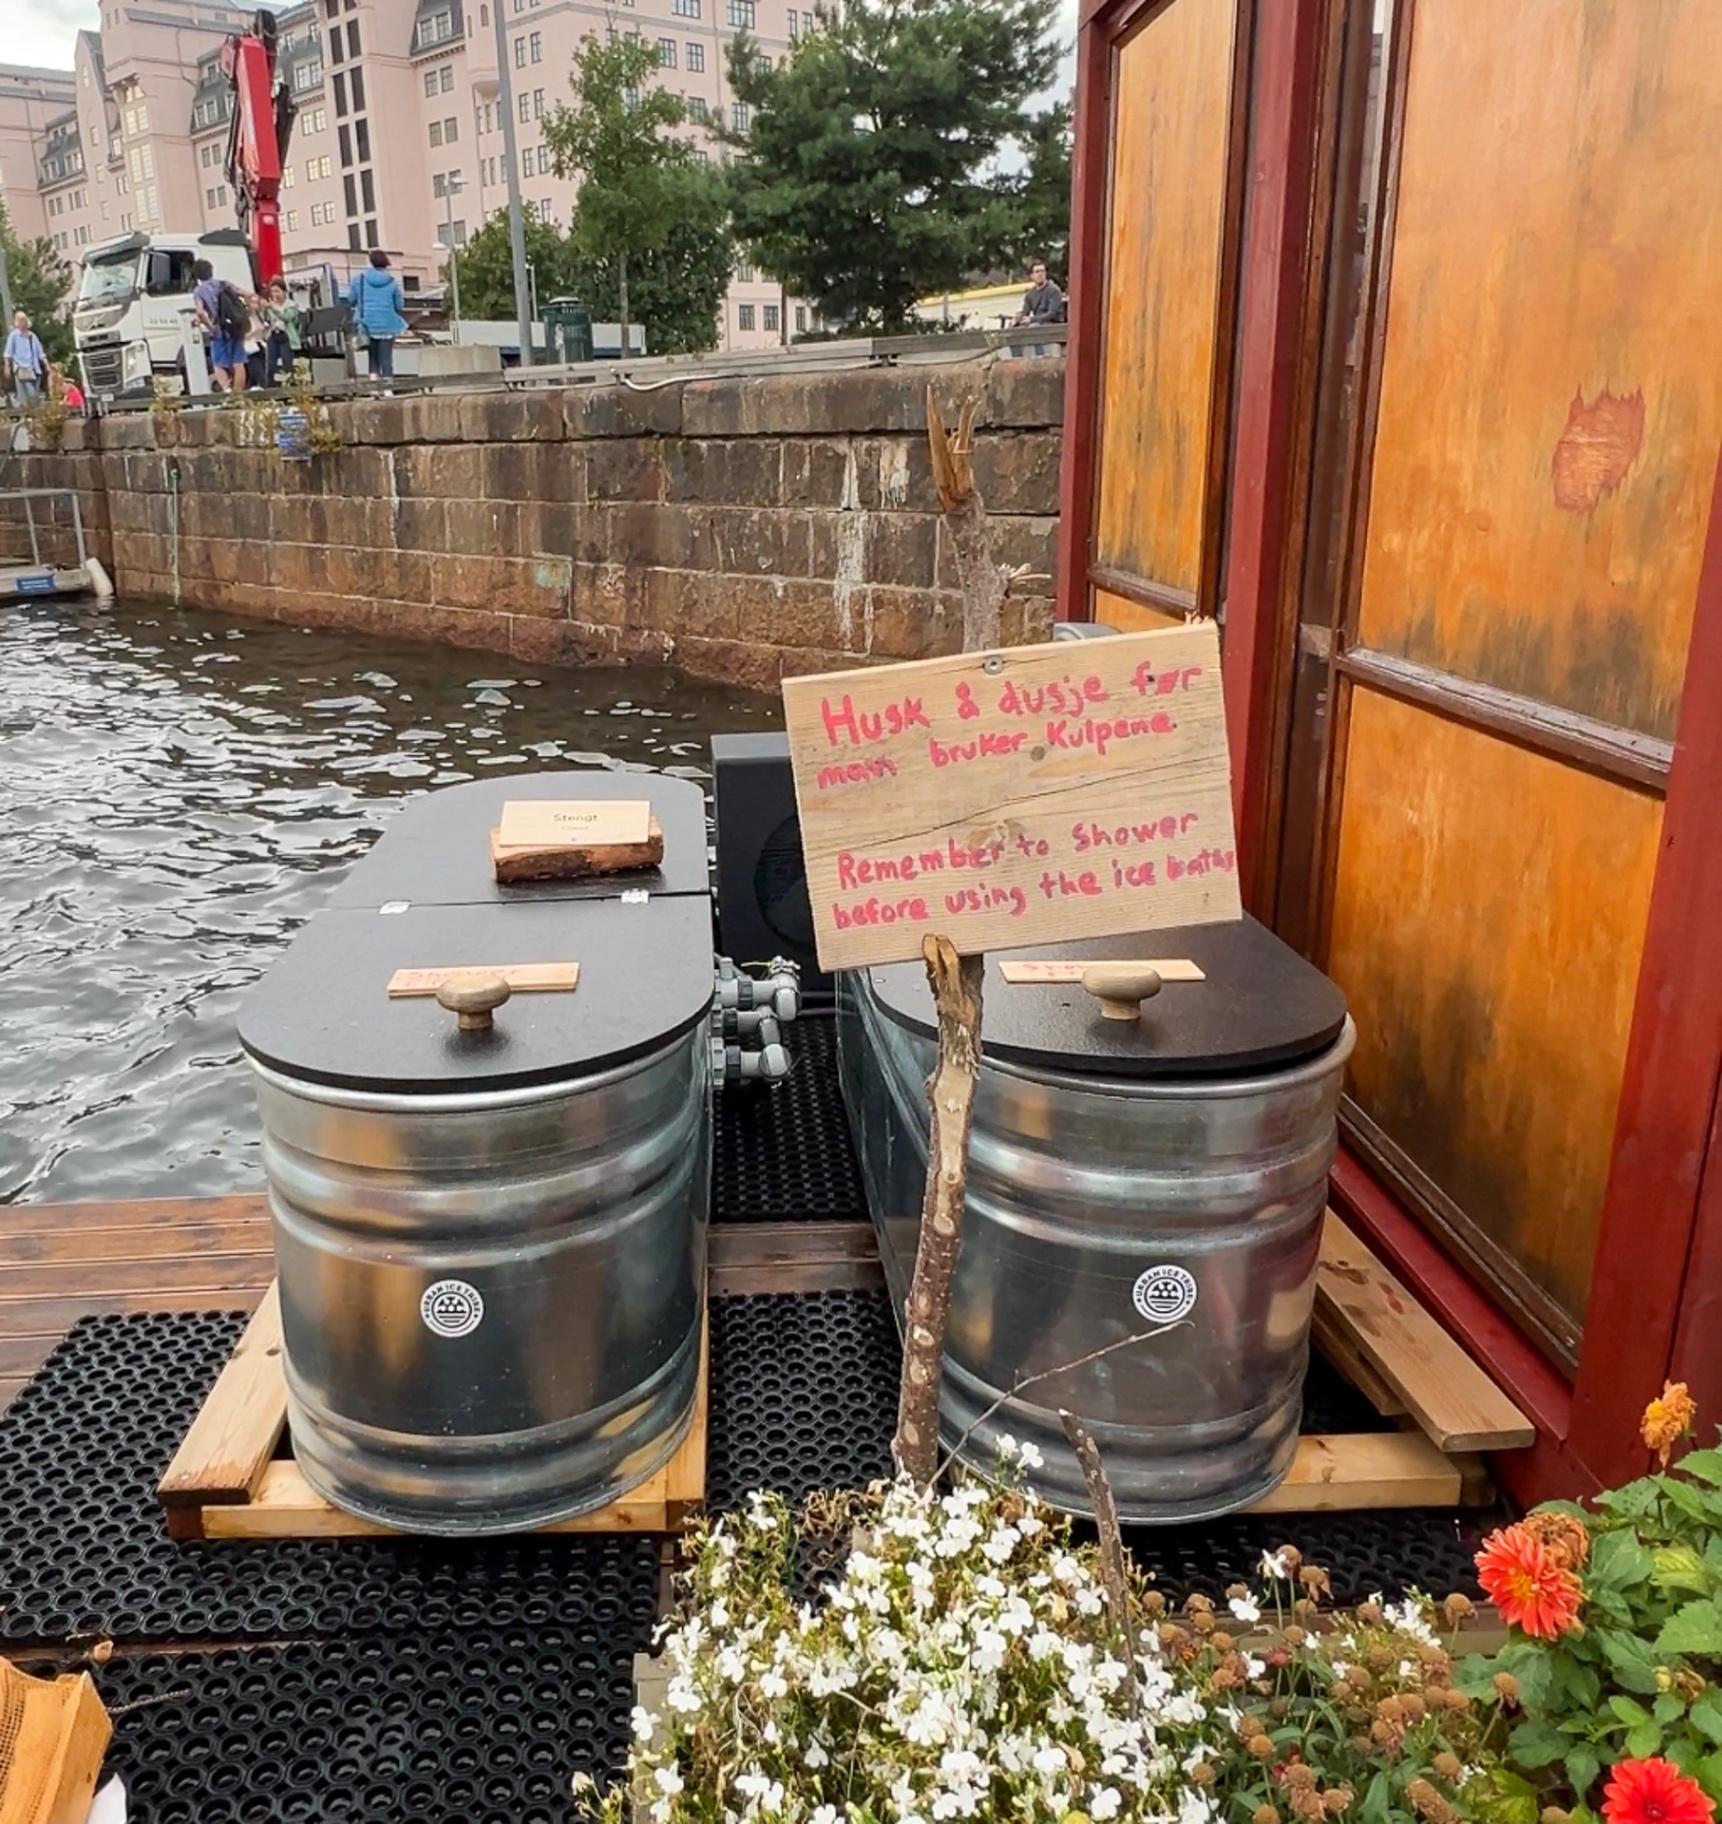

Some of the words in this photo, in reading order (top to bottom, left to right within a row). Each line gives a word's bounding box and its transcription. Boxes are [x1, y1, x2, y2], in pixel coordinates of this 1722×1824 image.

[821, 694, 931, 746] Husk
[998, 674, 1110, 718] dusje
[1130, 660, 1202, 696] før
[928, 732, 1028, 768] bruker
[837, 836, 1005, 890] Remember
[1017, 833, 1049, 857] to
[832, 897, 929, 930] before
[945, 882, 1027, 917] using
[1039, 870, 1102, 899] the
[1111, 858, 1156, 889] ice
[1162, 1269, 1179, 1277] ICE
